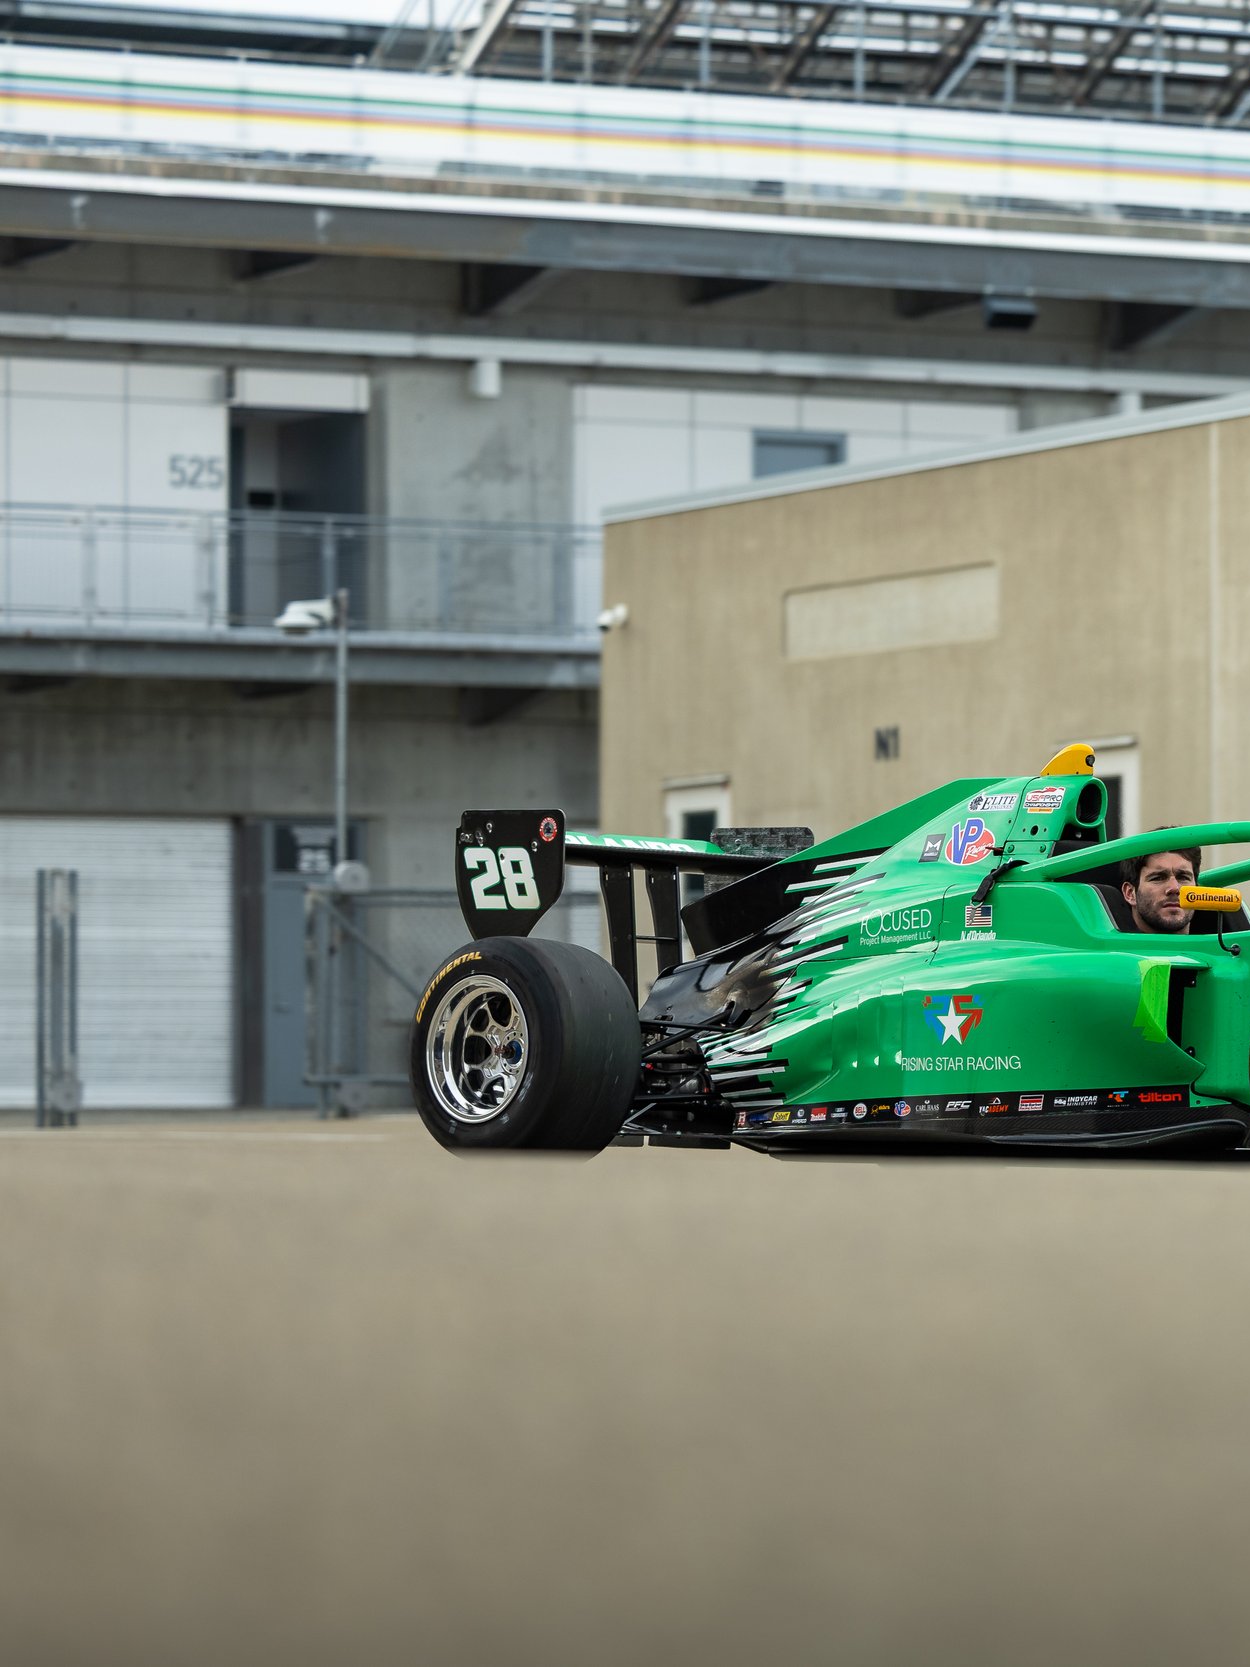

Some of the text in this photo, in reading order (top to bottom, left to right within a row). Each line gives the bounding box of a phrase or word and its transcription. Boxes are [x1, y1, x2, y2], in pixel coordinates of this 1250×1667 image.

[168, 454, 224, 491] 525
[981, 795, 1017, 811] ELITE
[952, 818, 985, 864] VP
[464, 847, 541, 910] 28
[1186, 892, 1233, 902] Continental
[860, 931, 931, 946] Project Management LLC
[416, 951, 482, 1024] CONTINENTAL
[901, 1055, 1022, 1071] RISING STAR RACING
[946, 1101, 972, 1109] PFC
[1138, 1091, 1182, 1103] tilton
